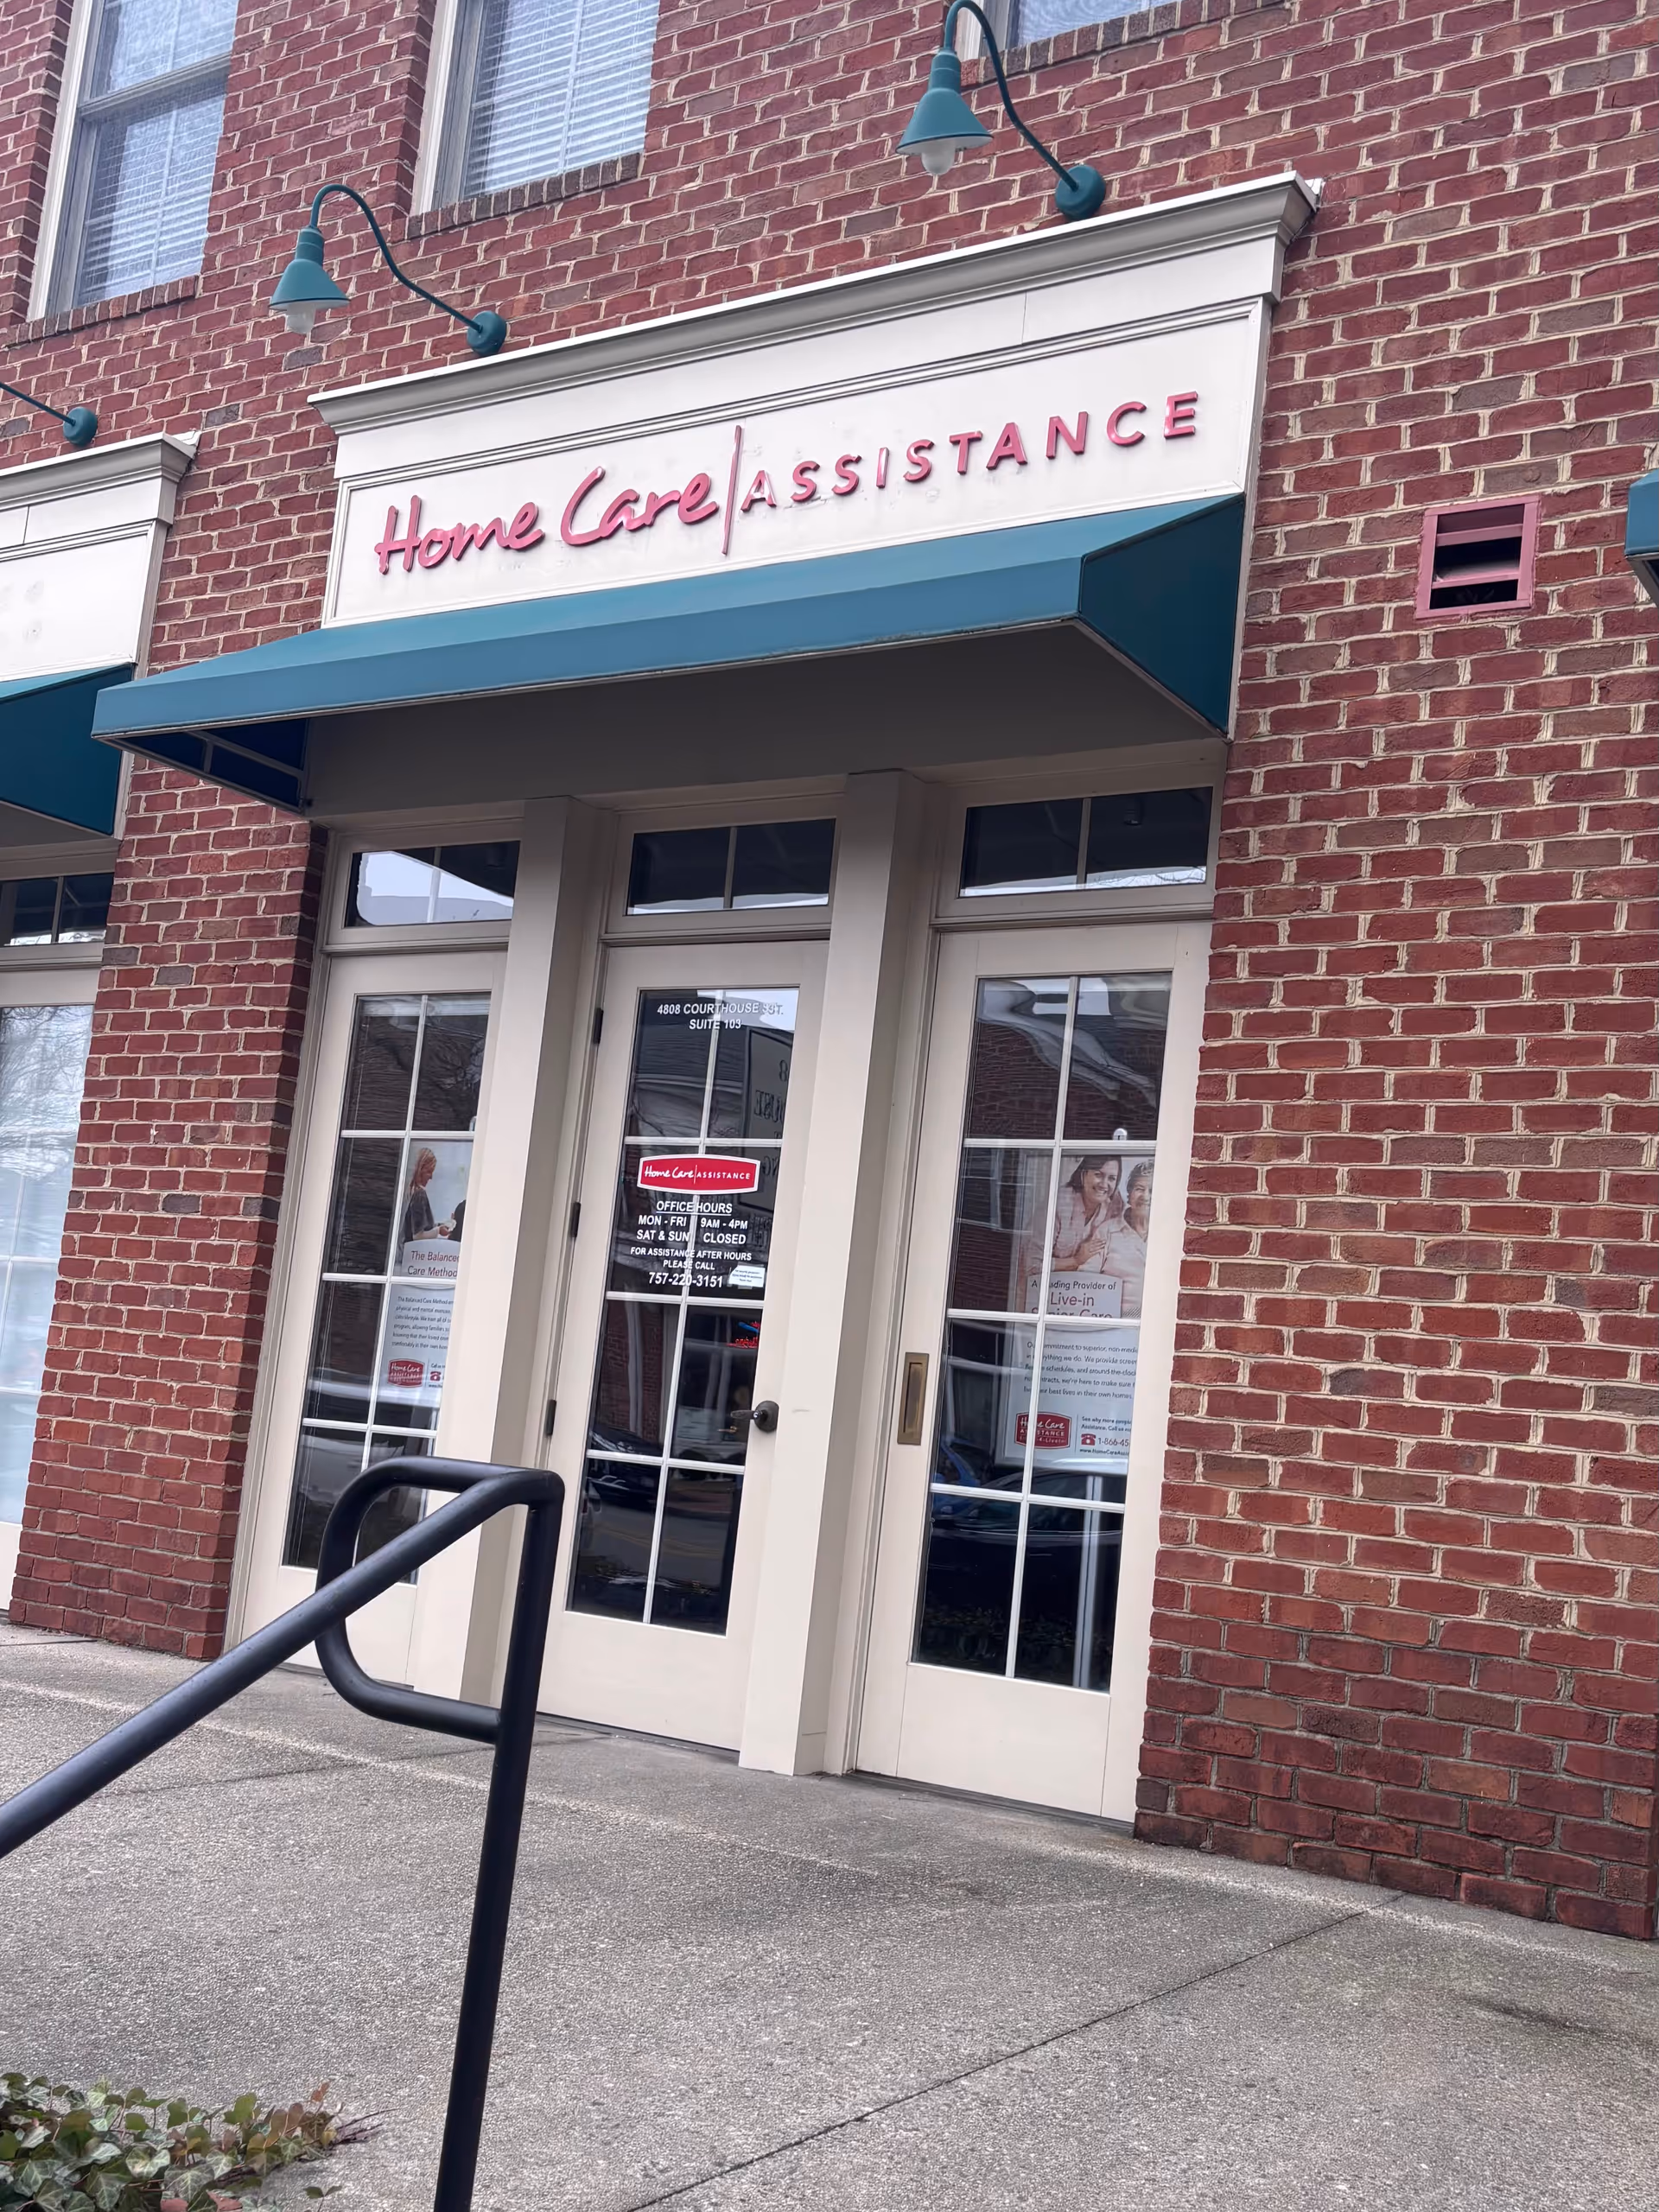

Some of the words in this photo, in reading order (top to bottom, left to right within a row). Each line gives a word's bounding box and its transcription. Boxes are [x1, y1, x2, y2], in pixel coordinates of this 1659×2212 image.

[374, 493, 545, 574] Home
[561, 467, 720, 546] Care
[741, 391, 1198, 513] ASSISTANCE
[658, 1004, 681, 1014] 4808
[683, 1002, 760, 1014] COURTHOUSE
[689, 1019, 721, 1030] SUITE
[645, 1165, 671, 1178] Home
[672, 1166, 695, 1179] Care
[696, 1171, 751, 1179] ASSISTANCE
[657, 1200, 693, 1212] OFFICE
[697, 1202, 733, 1214] HOURS
[639, 1215, 662, 1226] MON
[670, 1217, 688, 1227] FRI
[701, 1217, 721, 1229] 9AM
[728, 1219, 748, 1230] 4PM
[636, 1230, 657, 1241] SAT
[658, 1230, 665, 1242] &
[668, 1231, 690, 1243] SUN
[703, 1233, 747, 1245] CLOSED
[411, 1250, 425, 1261] The
[631, 1247, 646, 1255] FOR
[647, 1248, 695, 1259] ASSISTANCE
[696, 1250, 721, 1260] AFTER
[724, 1251, 752, 1262] HOURS
[408, 1265, 425, 1275] Care
[663, 1260, 693, 1270] PLEASE
[695, 1262, 715, 1270] CALL
[649, 1272, 723, 1288] 757-220-3151
[1073, 1281, 1106, 1290] Provider
[1108, 1281, 1116, 1290] of
[1050, 1292, 1094, 1306] Live-in
[1045, 1419, 1065, 1429] Care
[1098, 1438, 1129, 1447] 1-866-45
